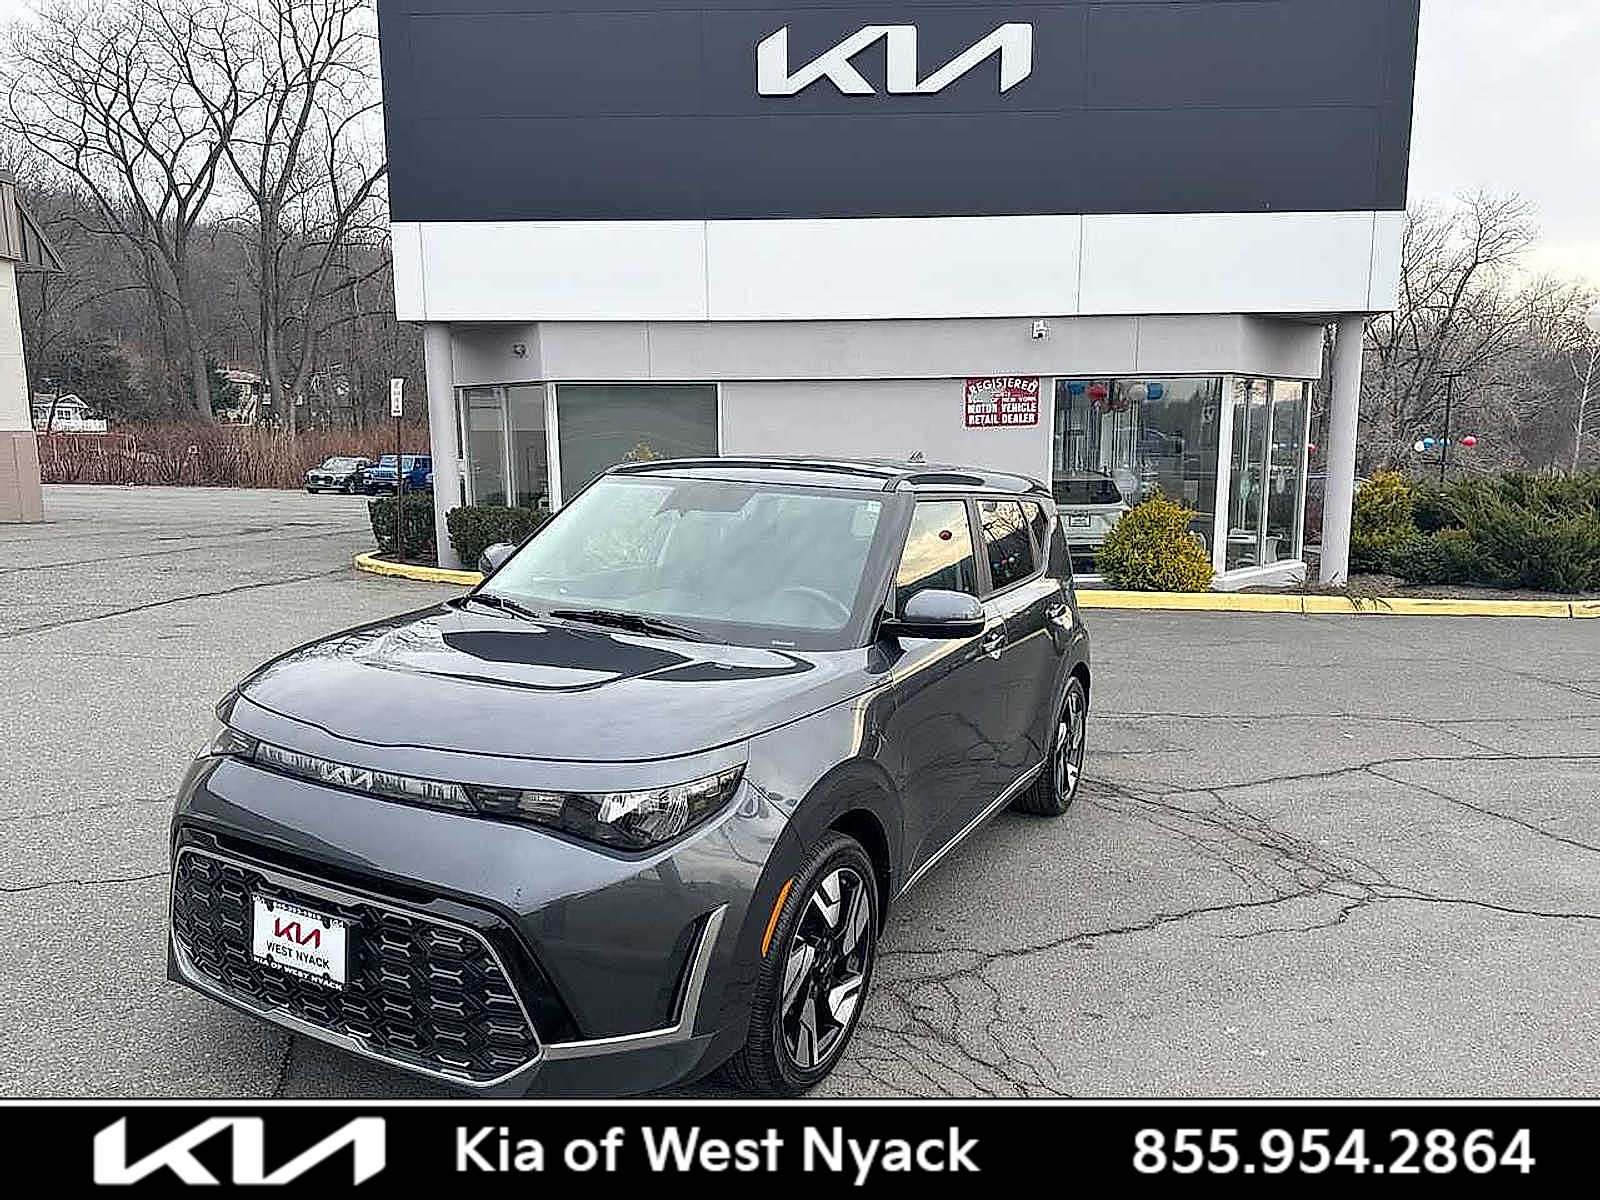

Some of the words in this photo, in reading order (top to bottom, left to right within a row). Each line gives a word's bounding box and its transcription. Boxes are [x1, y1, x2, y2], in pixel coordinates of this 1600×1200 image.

[757, 22, 1034, 97] KIA
[968, 377, 1039, 394] REGISTERED
[967, 403, 998, 414] MOTOR
[1001, 402, 1038, 413] VEHICLE
[968, 413, 999, 424] RETAIL
[1001, 413, 1035, 424] DEALER
[274, 917, 321, 949] KIA
[266, 940, 293, 958] WEST
[296, 950, 330, 970] NYACK
